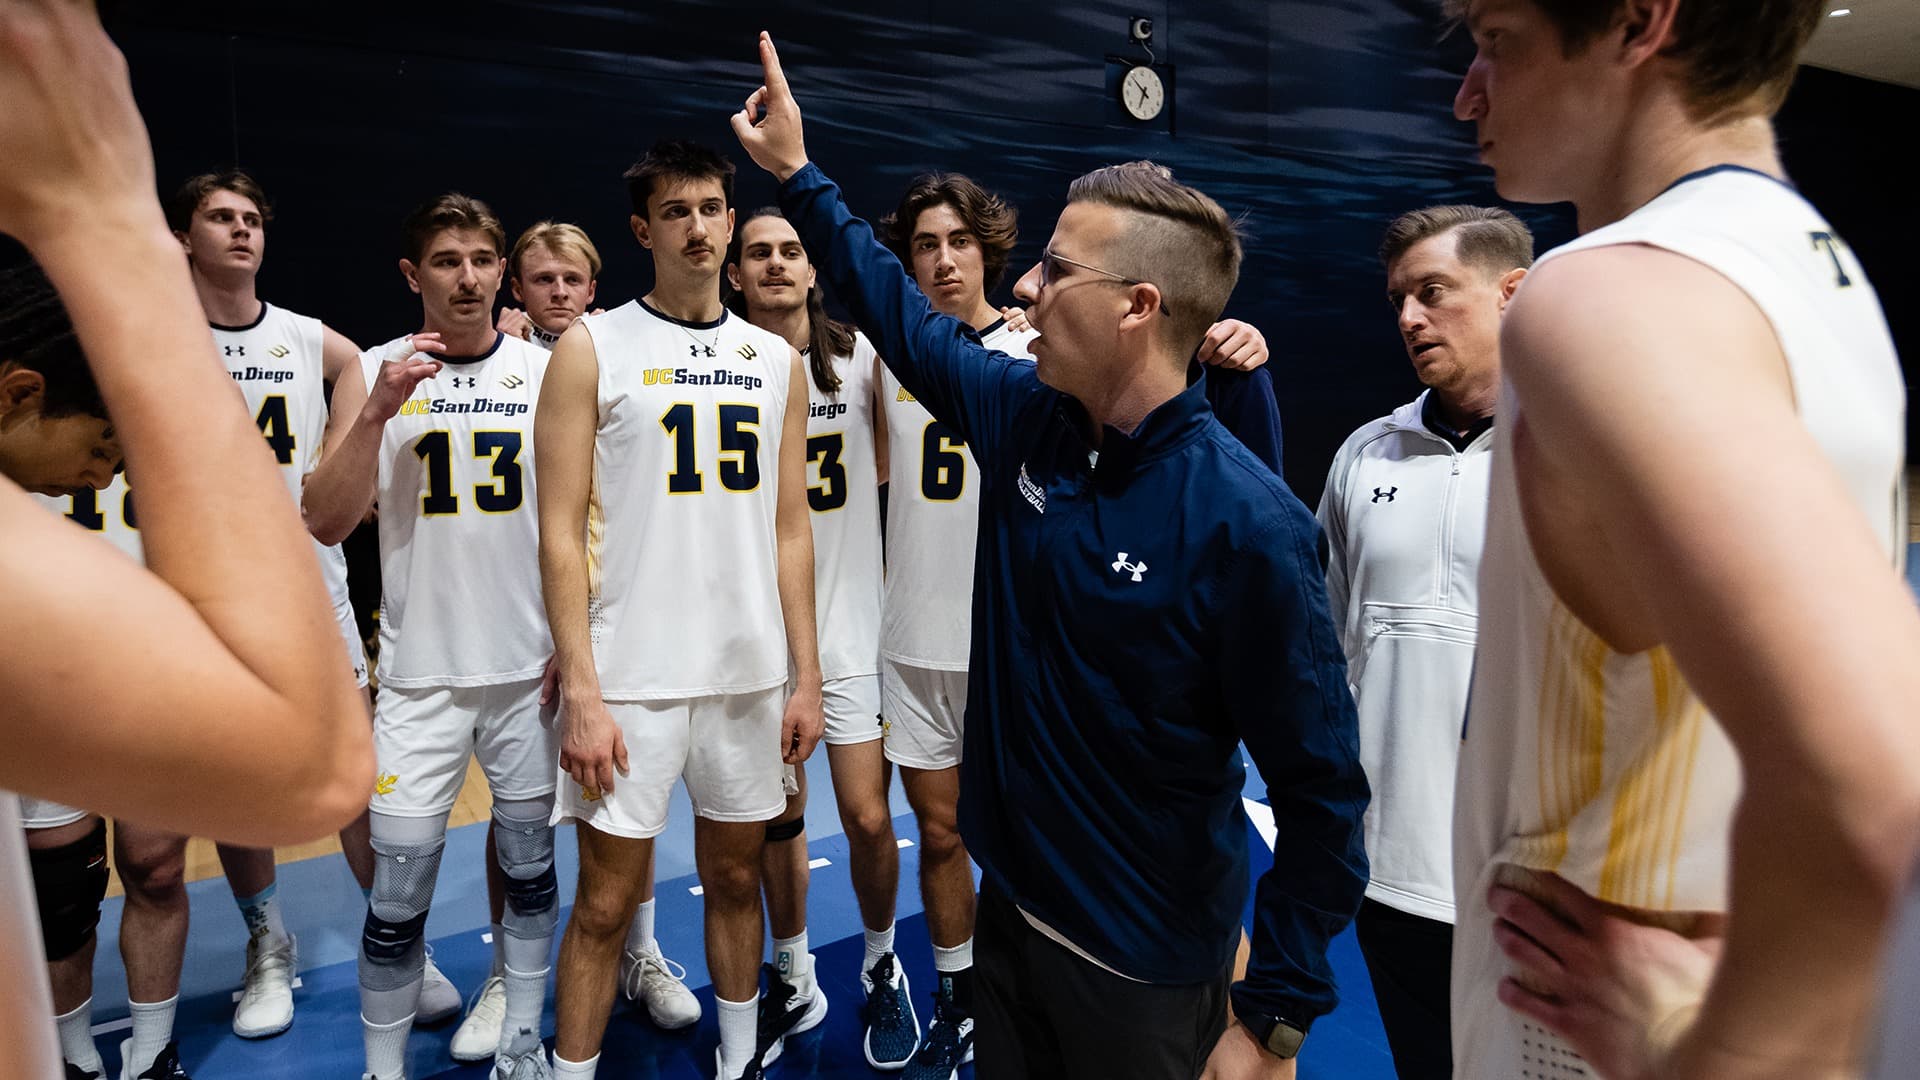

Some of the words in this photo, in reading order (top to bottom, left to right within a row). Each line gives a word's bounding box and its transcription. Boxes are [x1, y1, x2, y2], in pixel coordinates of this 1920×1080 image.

[228, 366, 295, 384] nDiego
[642, 367, 763, 391] UCSanDiego
[808, 402, 848, 420] iego
[413, 429, 524, 517] 13
[658, 401, 762, 496] 15
[806, 431, 848, 514] 3
[919, 418, 968, 504] 6
